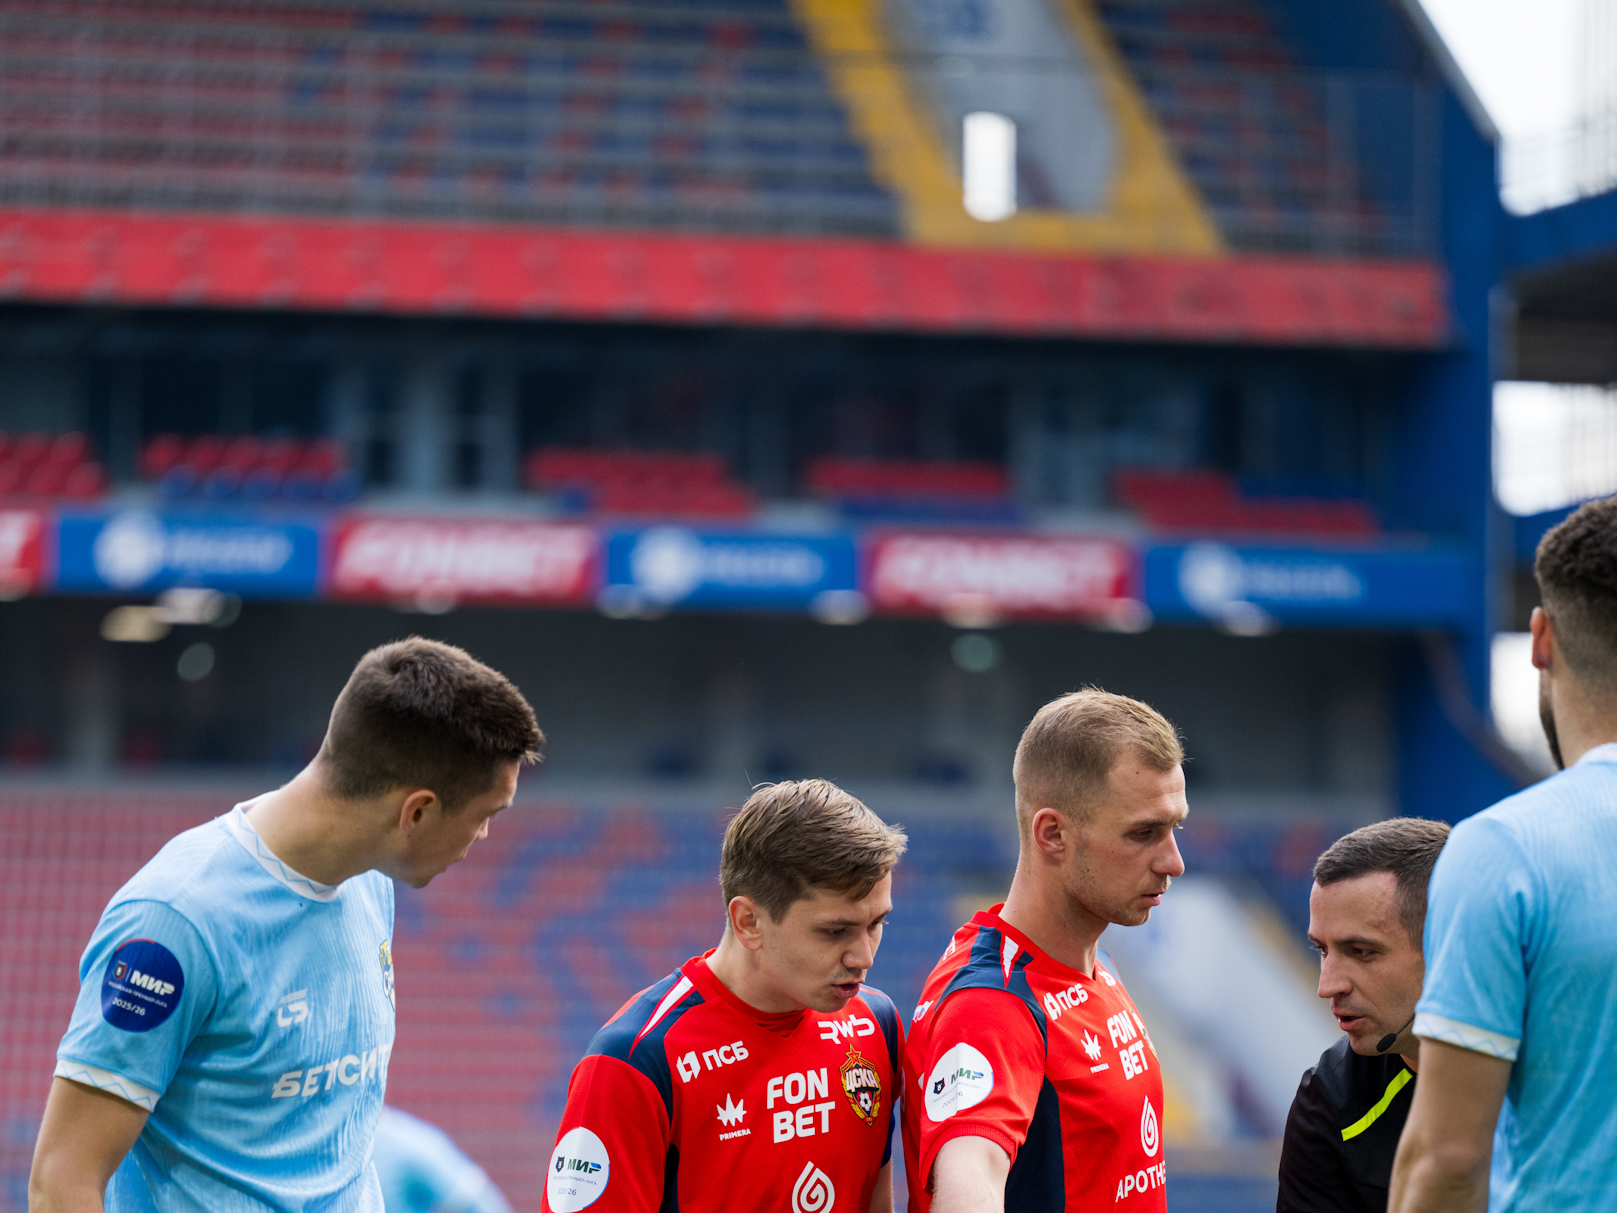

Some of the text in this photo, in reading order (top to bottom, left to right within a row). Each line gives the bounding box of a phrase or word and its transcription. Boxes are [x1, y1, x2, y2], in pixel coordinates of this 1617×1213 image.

[130, 969, 175, 996] МИР
[112, 997, 146, 1017] 2025/26
[1055, 983, 1089, 1010] ПСБ
[1107, 1009, 1138, 1049] FON
[702, 1040, 750, 1071] ПСБ
[1119, 1039, 1149, 1081] BET
[767, 1067, 829, 1110] FON
[846, 1067, 880, 1093] ЦСКА
[950, 1067, 985, 1084] МИР
[719, 1128, 751, 1141] PRIMERA
[773, 1101, 836, 1144] BET
[566, 1158, 602, 1175] МИР
